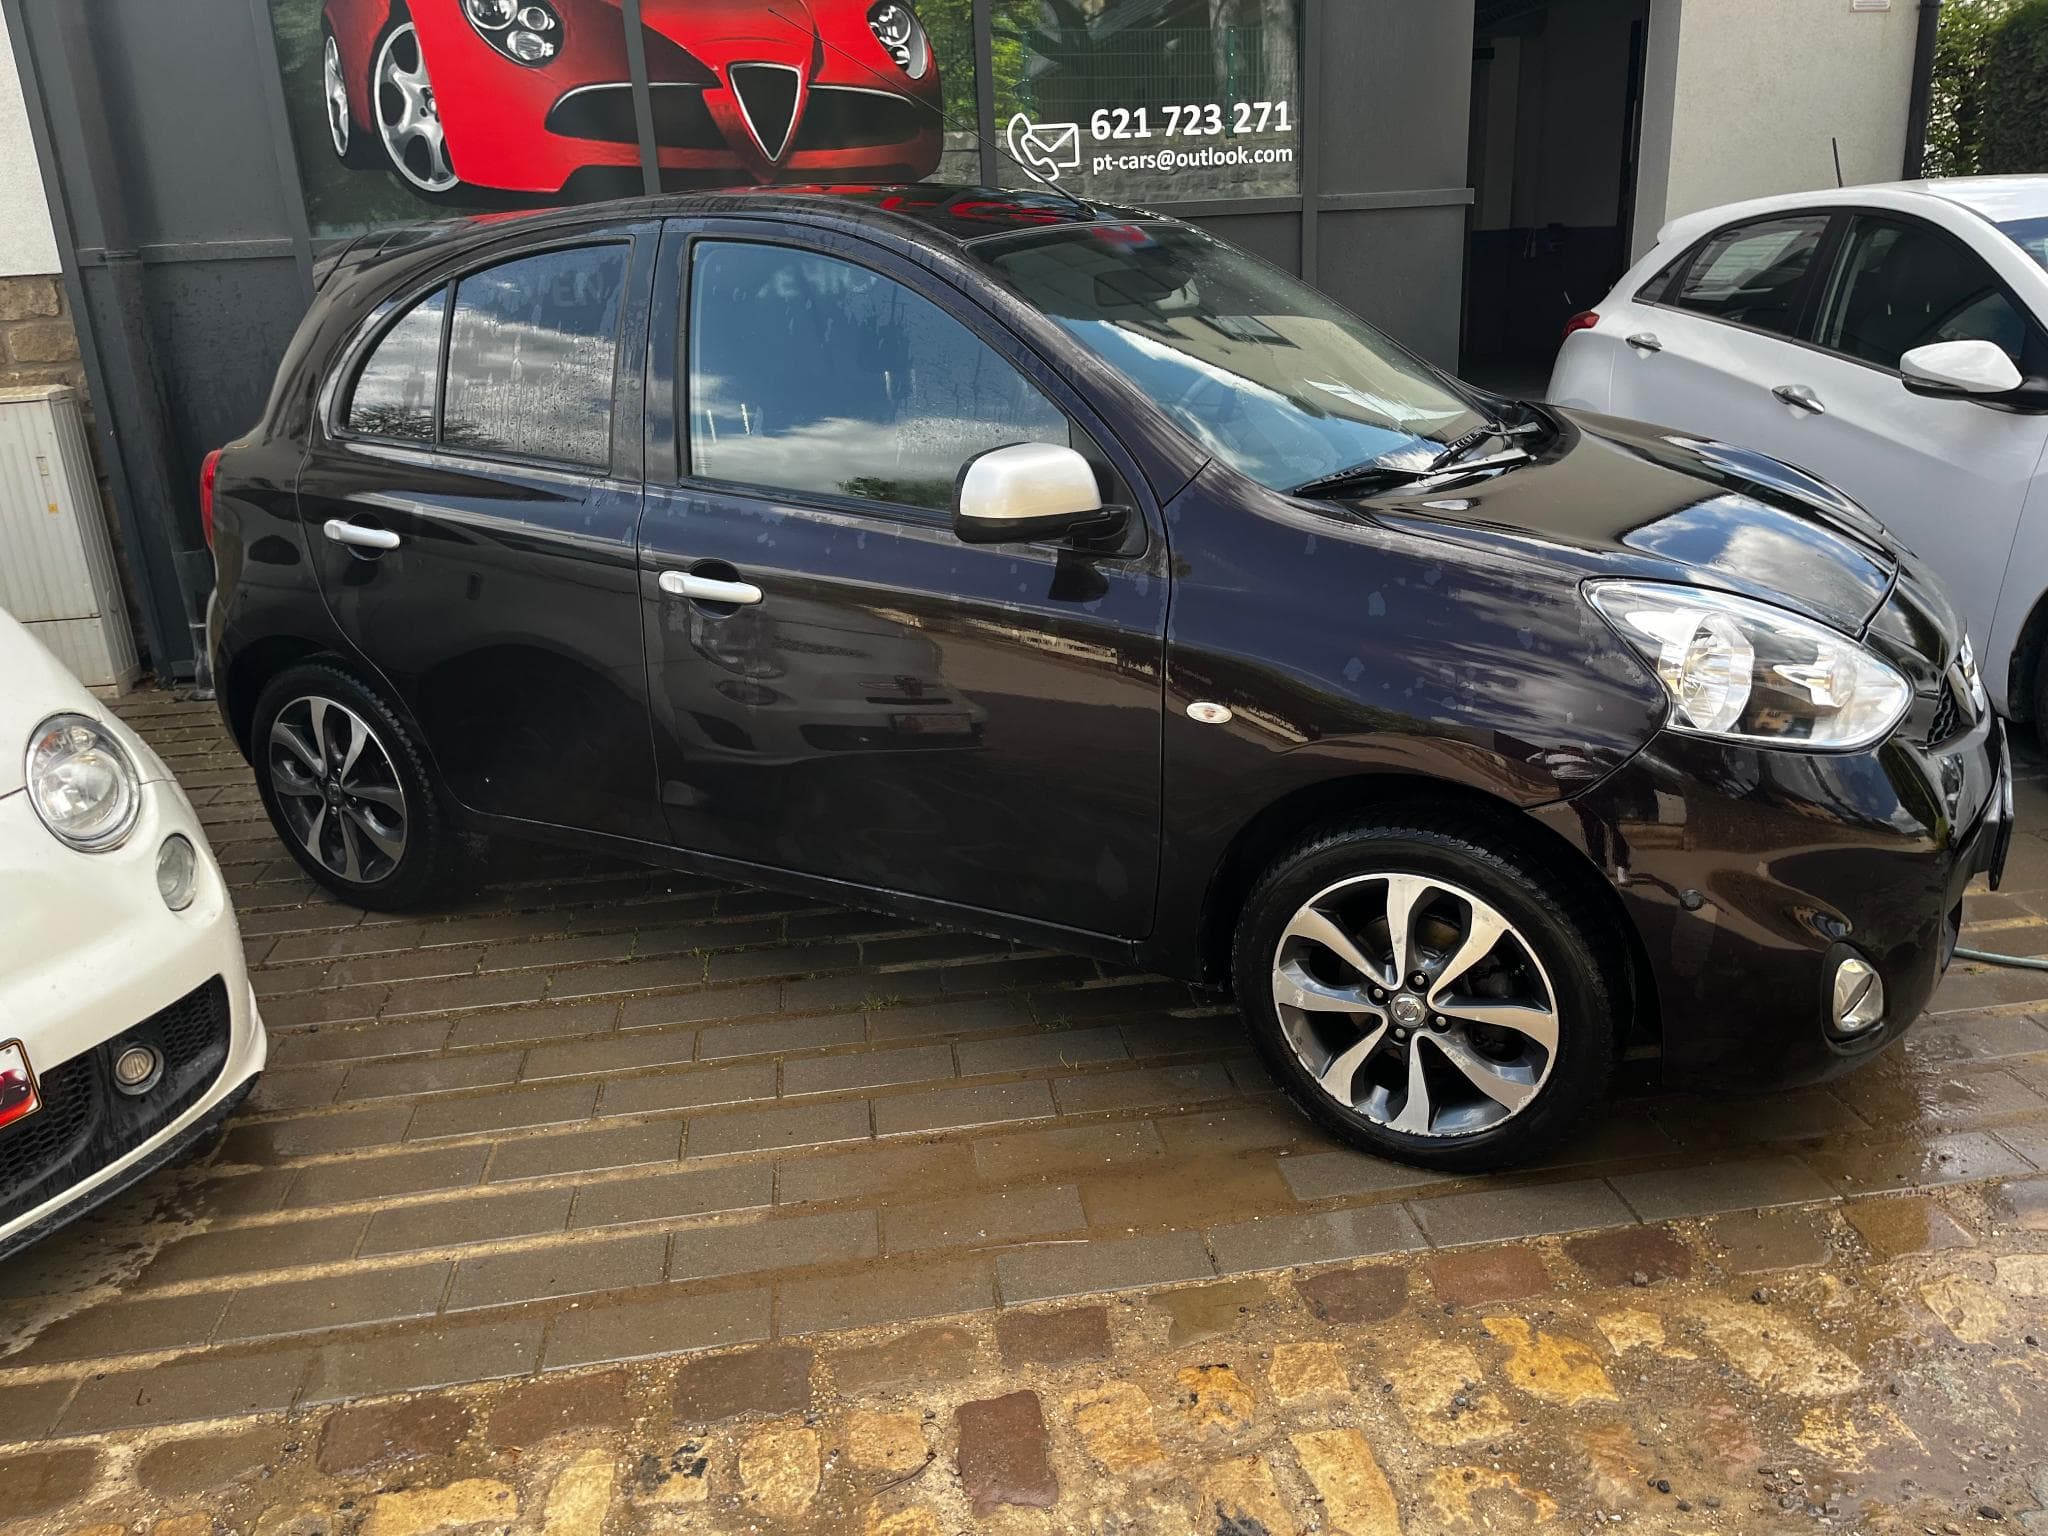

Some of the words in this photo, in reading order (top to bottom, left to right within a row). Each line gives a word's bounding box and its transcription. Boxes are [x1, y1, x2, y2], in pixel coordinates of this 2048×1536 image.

[1091, 108, 1151, 140] 621
[1162, 104, 1223, 137] 723
[1232, 101, 1292, 134] 271
[1093, 146, 1293, 175] pt-cars@outlook.com
